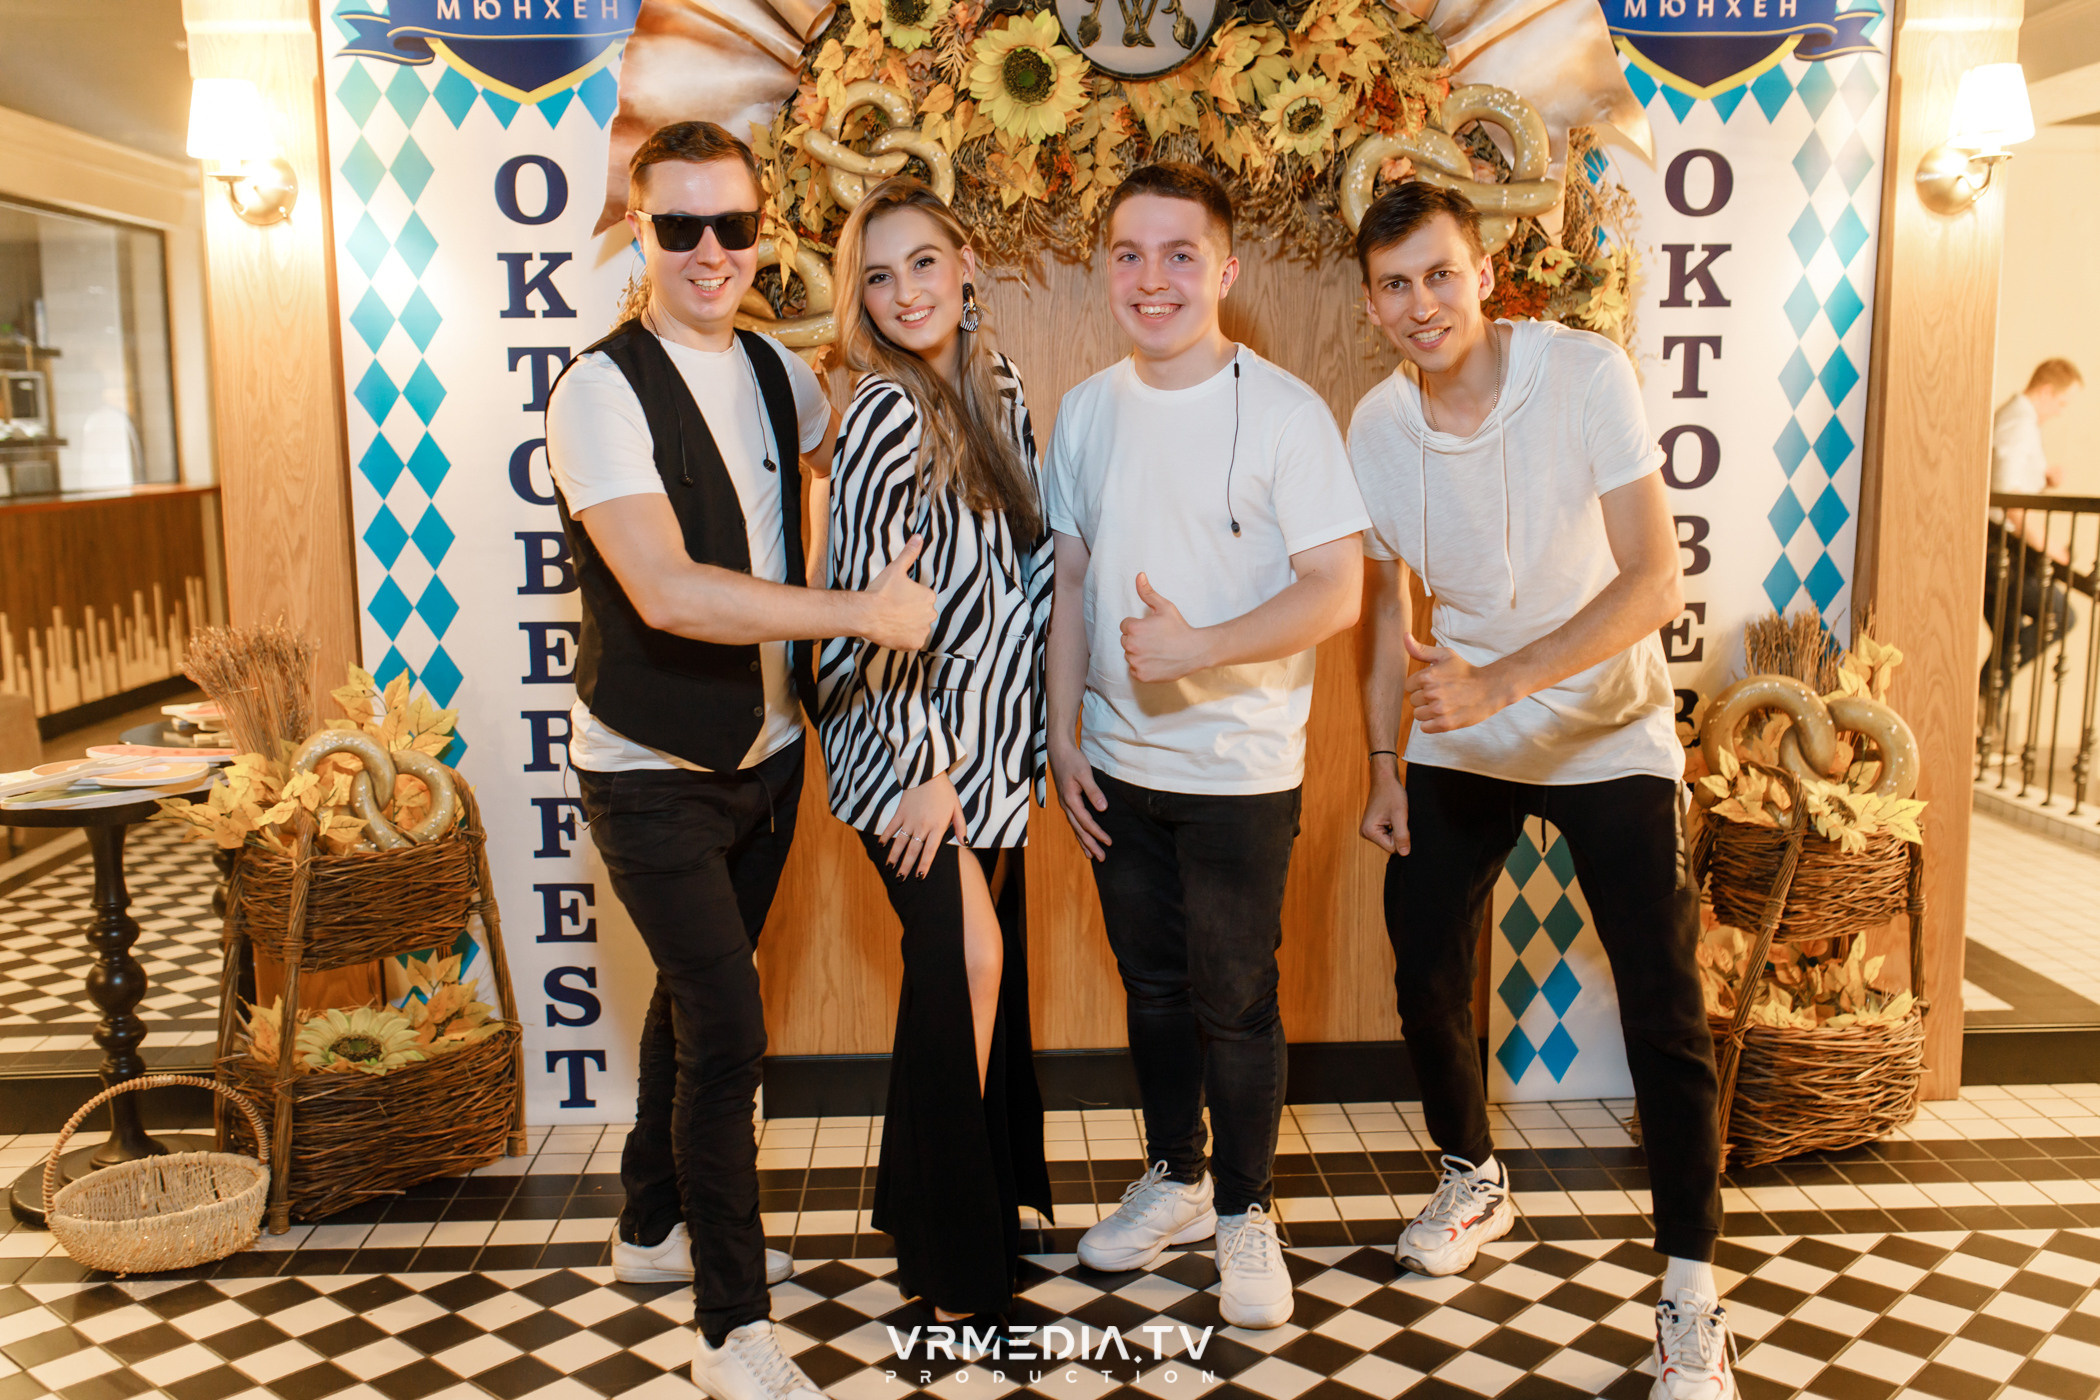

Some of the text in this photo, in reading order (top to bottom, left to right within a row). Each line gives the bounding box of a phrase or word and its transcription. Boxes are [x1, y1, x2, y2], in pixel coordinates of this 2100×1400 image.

[436, 0, 619, 20] МЮНХЕН
[1623, 0, 1797, 18] МЮНХЕН
[494, 154, 607, 1109] OKTOBERFEST
